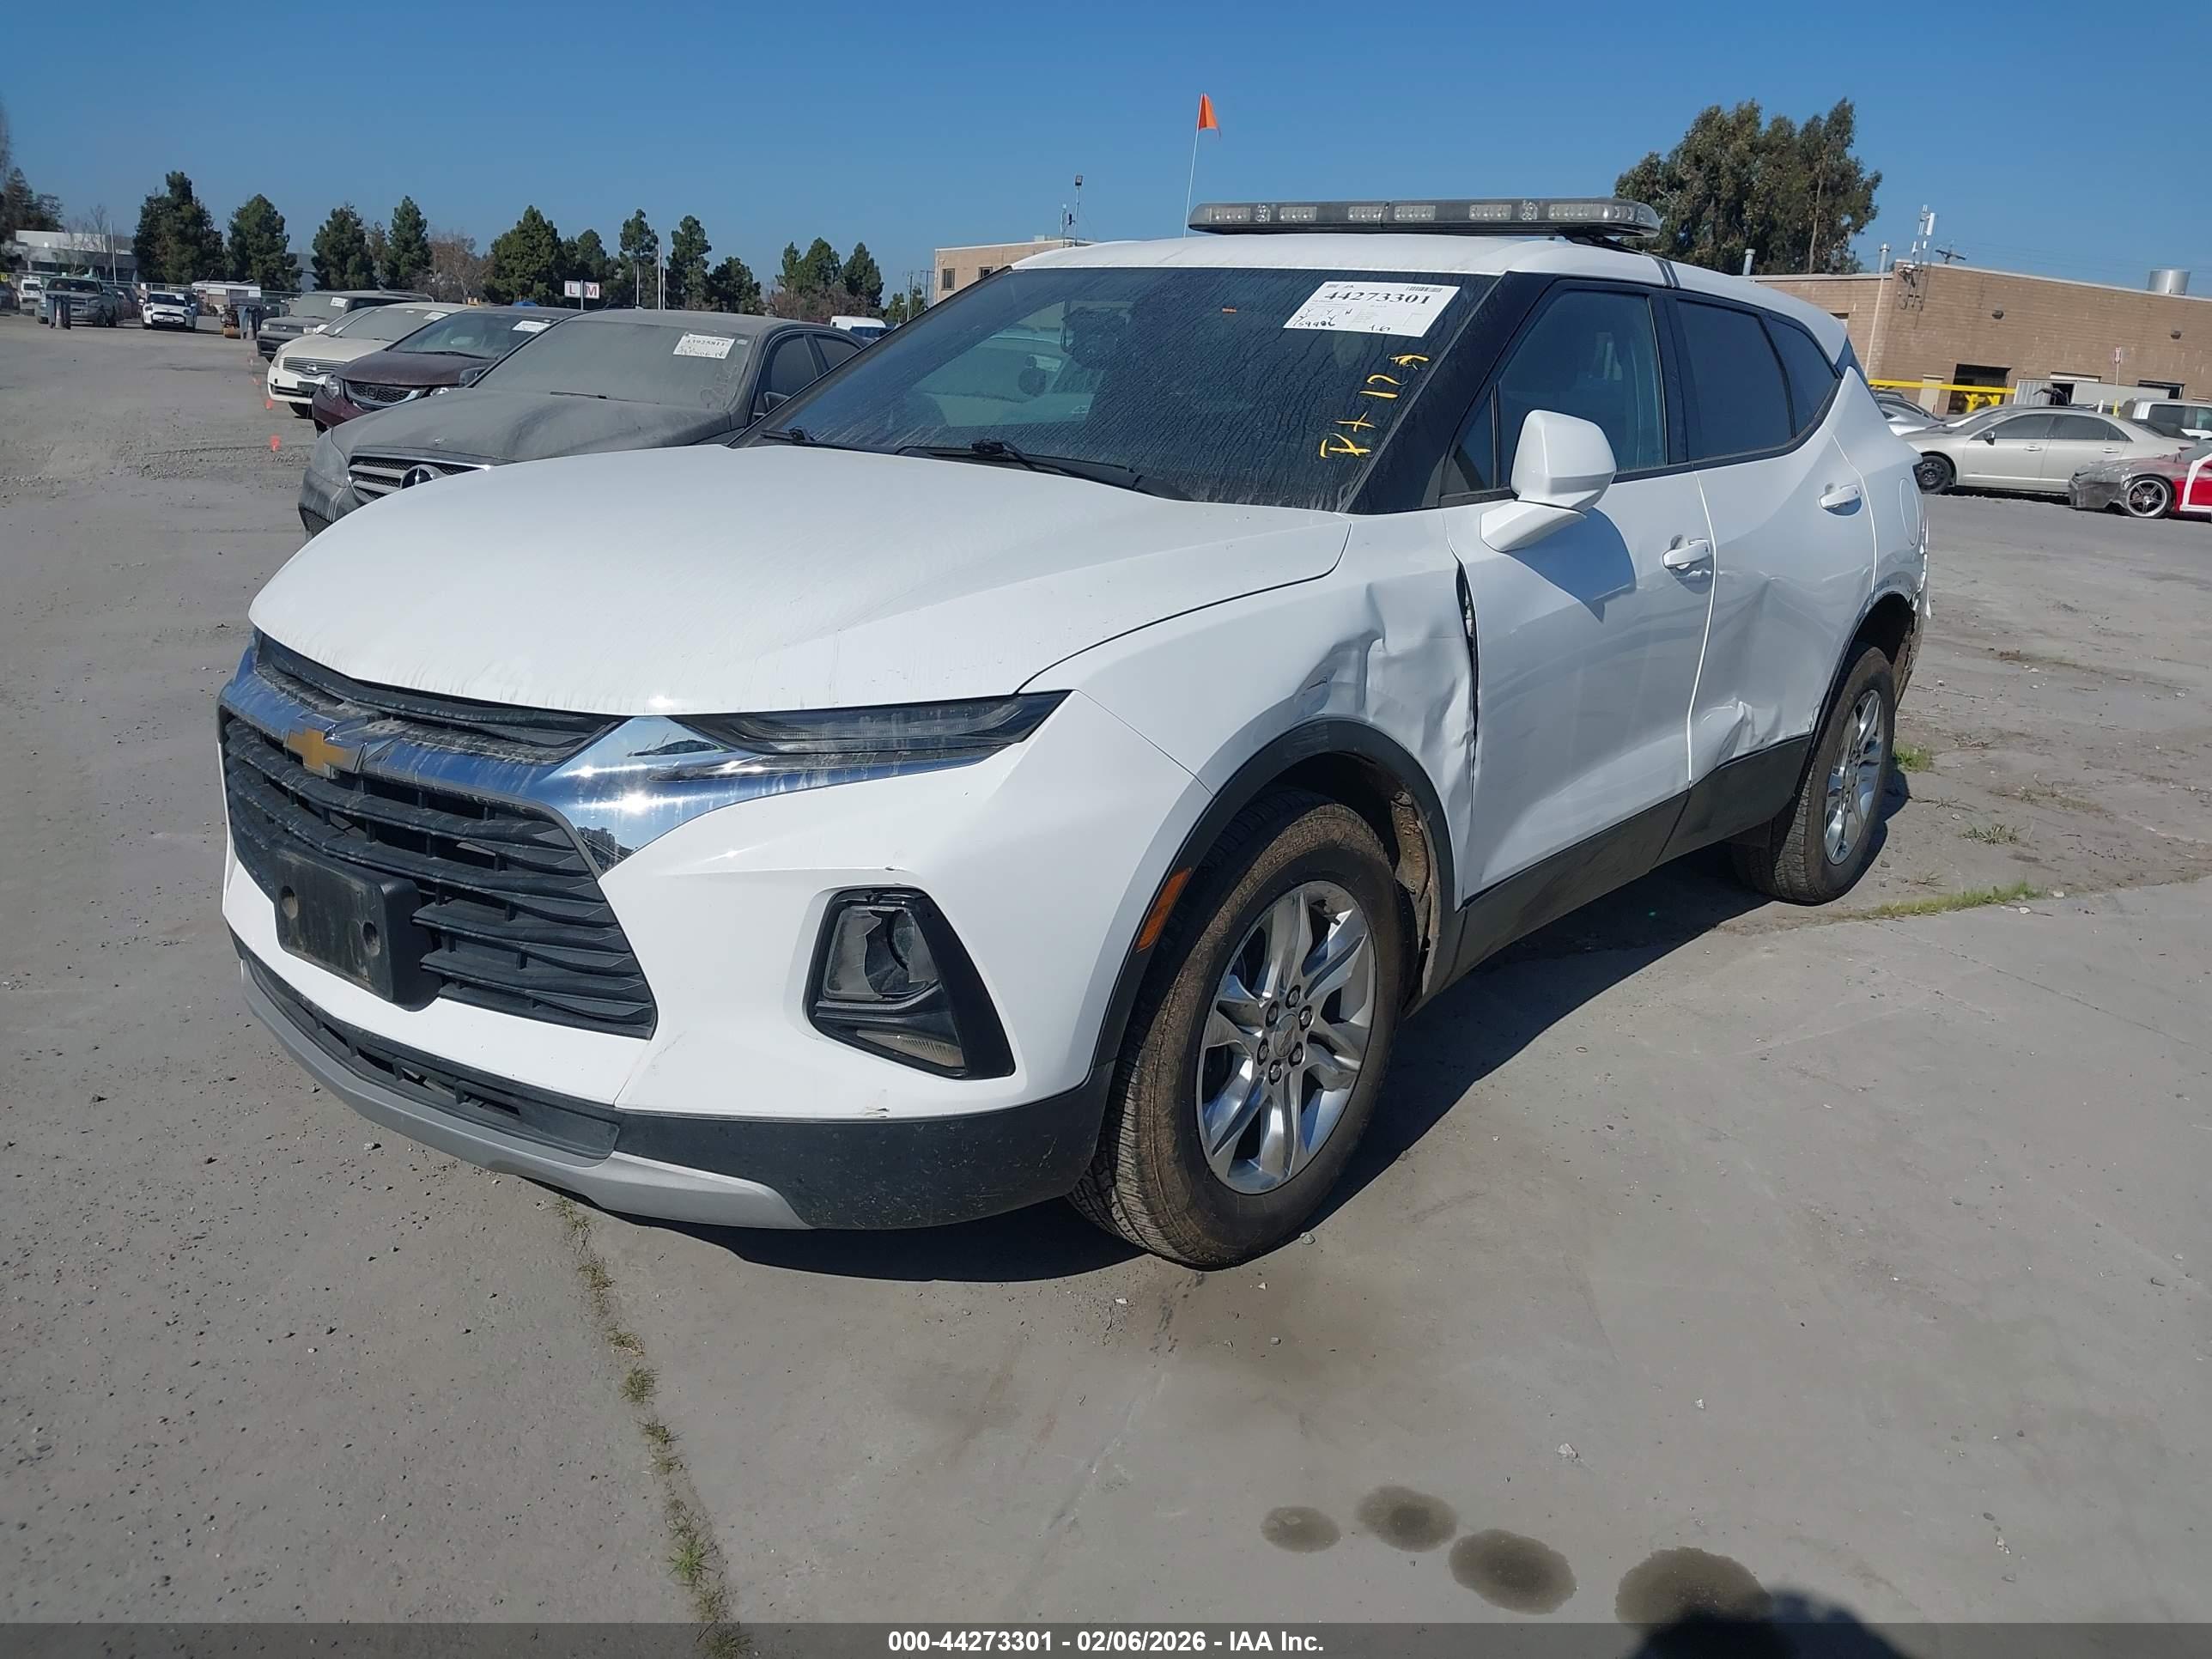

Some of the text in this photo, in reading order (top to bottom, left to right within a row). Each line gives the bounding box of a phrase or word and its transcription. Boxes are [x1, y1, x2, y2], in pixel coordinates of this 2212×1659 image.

[569, 284, 576, 295] L
[585, 285, 598, 296] M
[1324, 291, 1431, 305] 44273301
